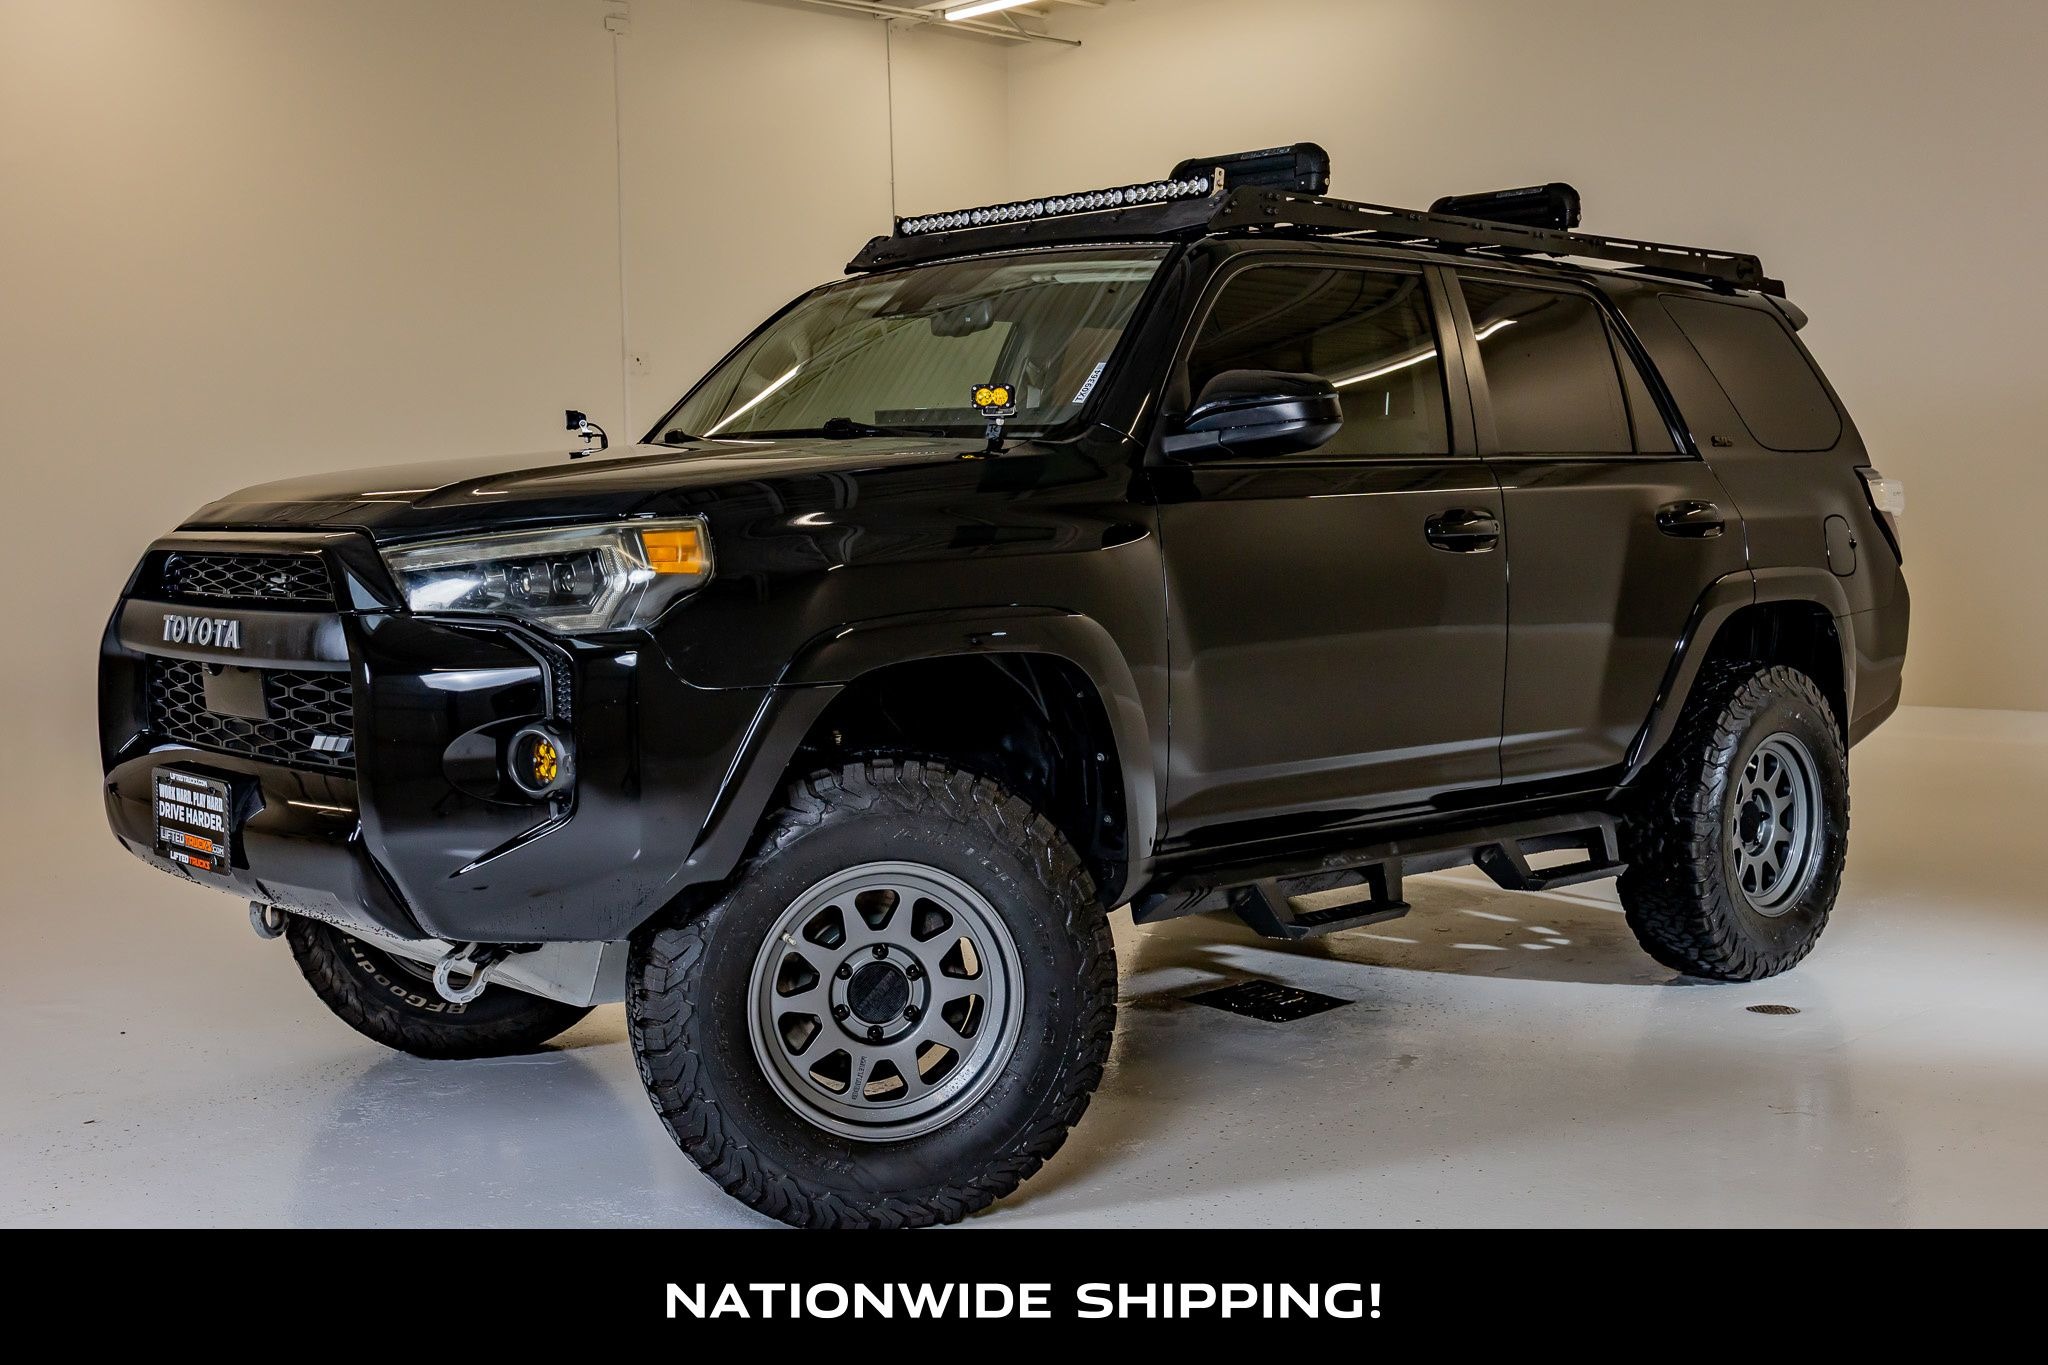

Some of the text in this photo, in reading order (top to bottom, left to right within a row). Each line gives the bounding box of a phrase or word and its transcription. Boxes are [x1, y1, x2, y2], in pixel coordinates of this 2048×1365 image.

[162, 614, 241, 650] TOYOTA
[158, 800, 225, 833] DRIVE HARDER.
